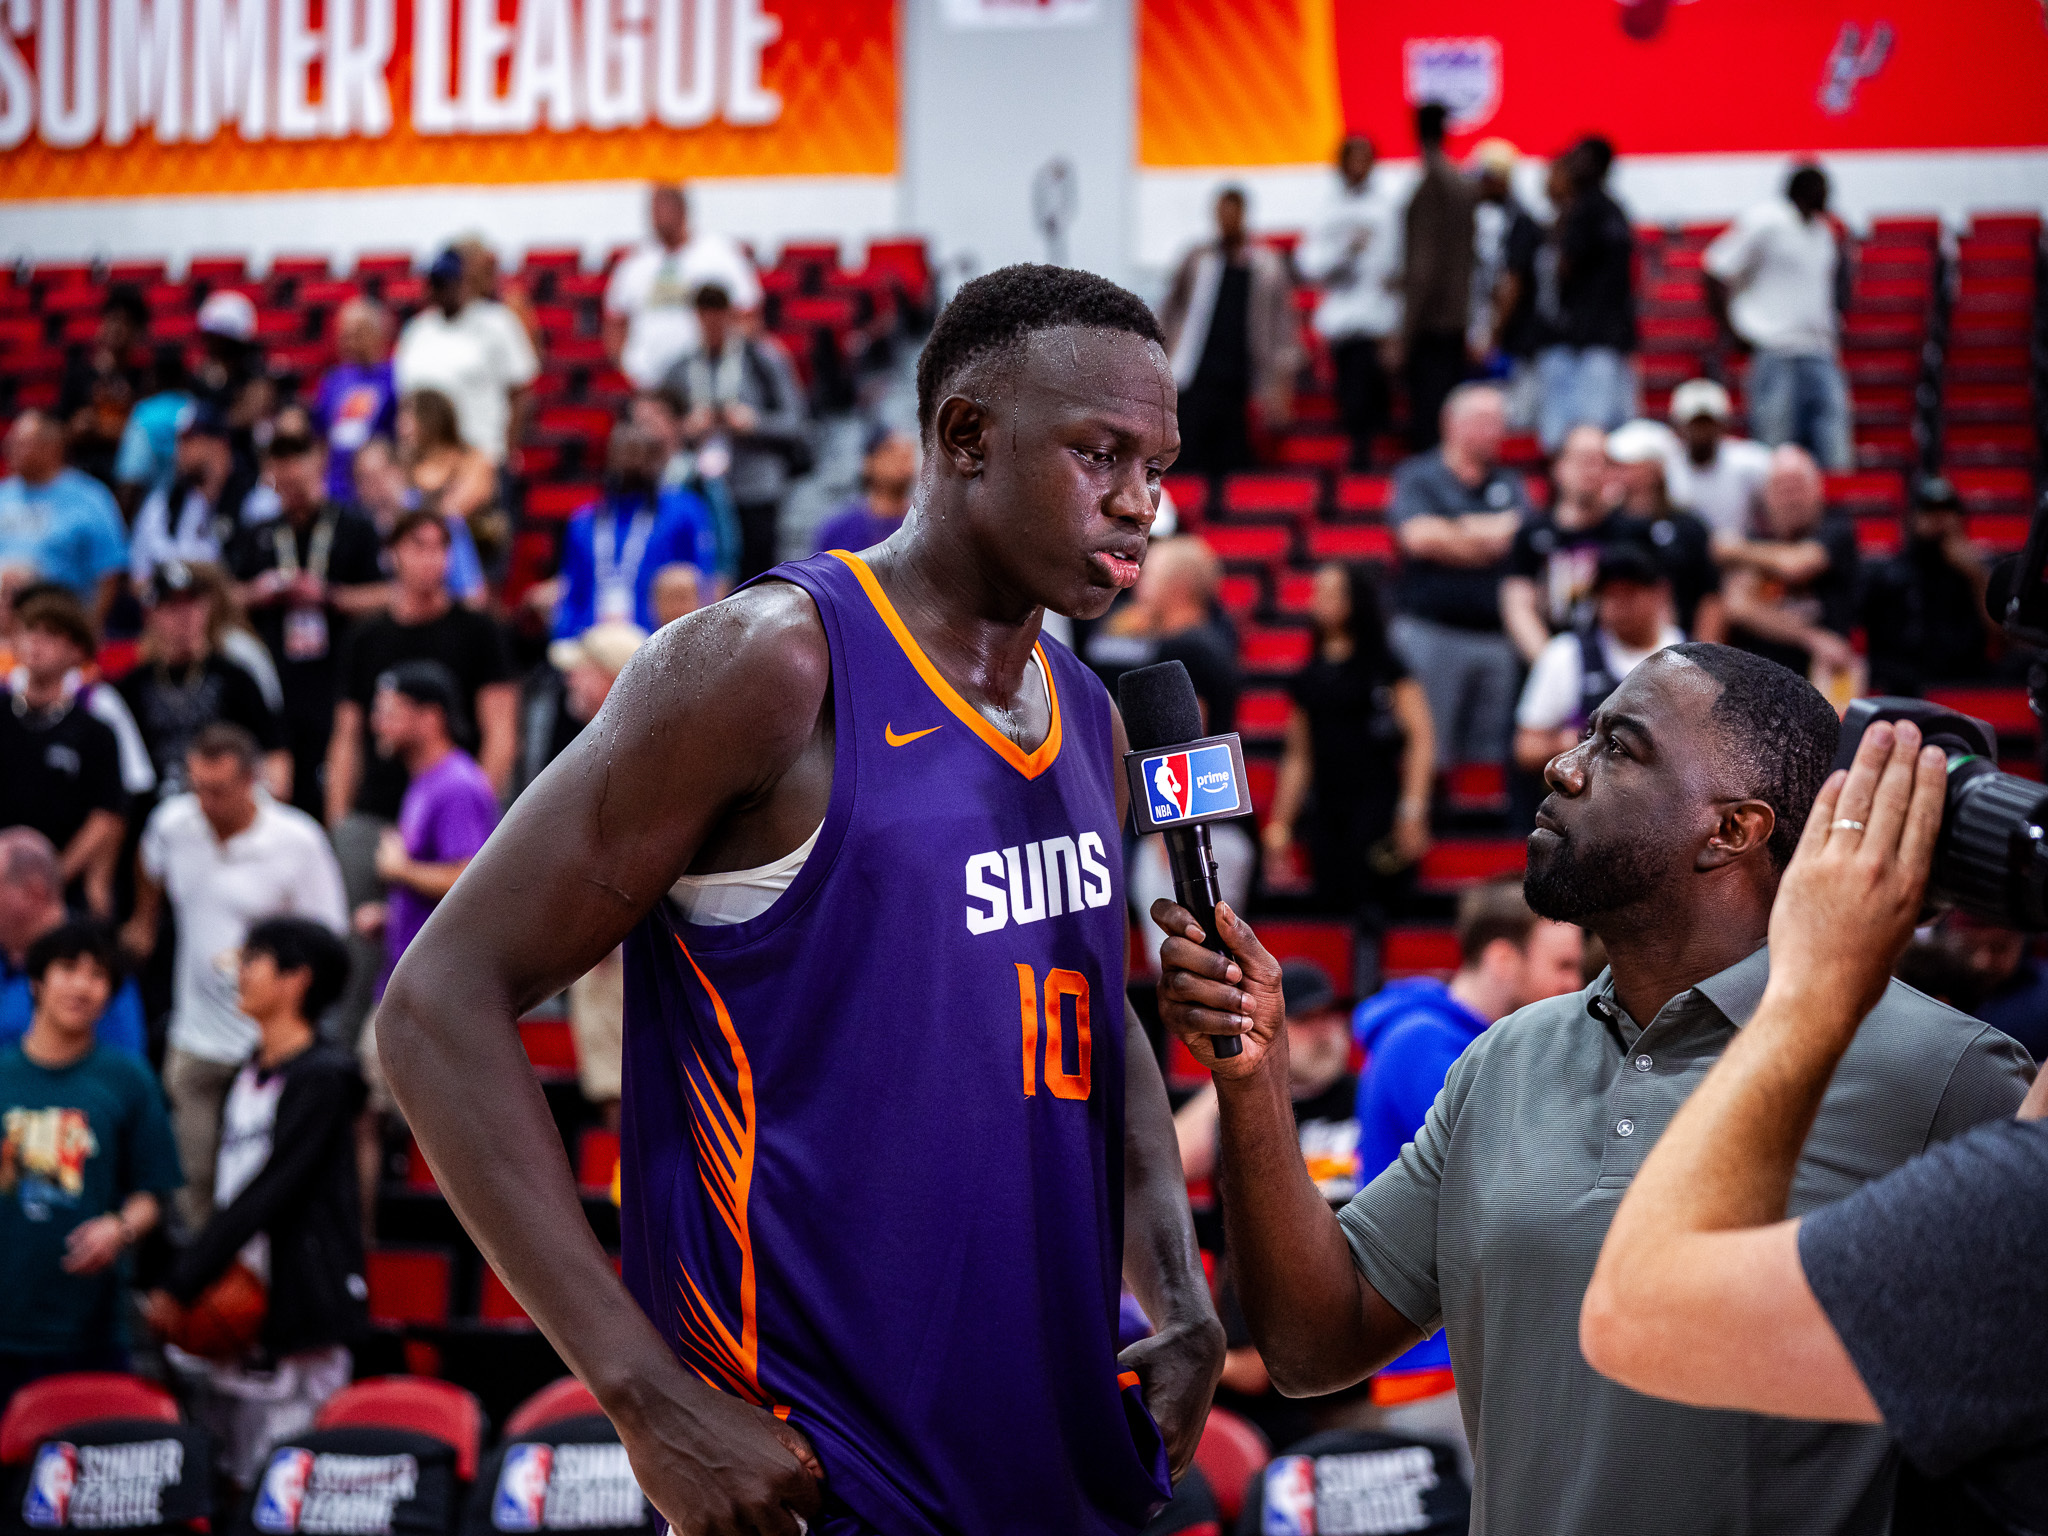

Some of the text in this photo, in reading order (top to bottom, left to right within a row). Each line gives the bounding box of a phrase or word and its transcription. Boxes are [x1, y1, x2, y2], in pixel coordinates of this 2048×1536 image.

[411, 0, 783, 133] LEAGUE
[1155, 804, 1172, 818] NBA
[1196, 771, 1229, 788] prime
[965, 831, 1112, 935] SUNS
[1014, 963, 1091, 1100] 10
